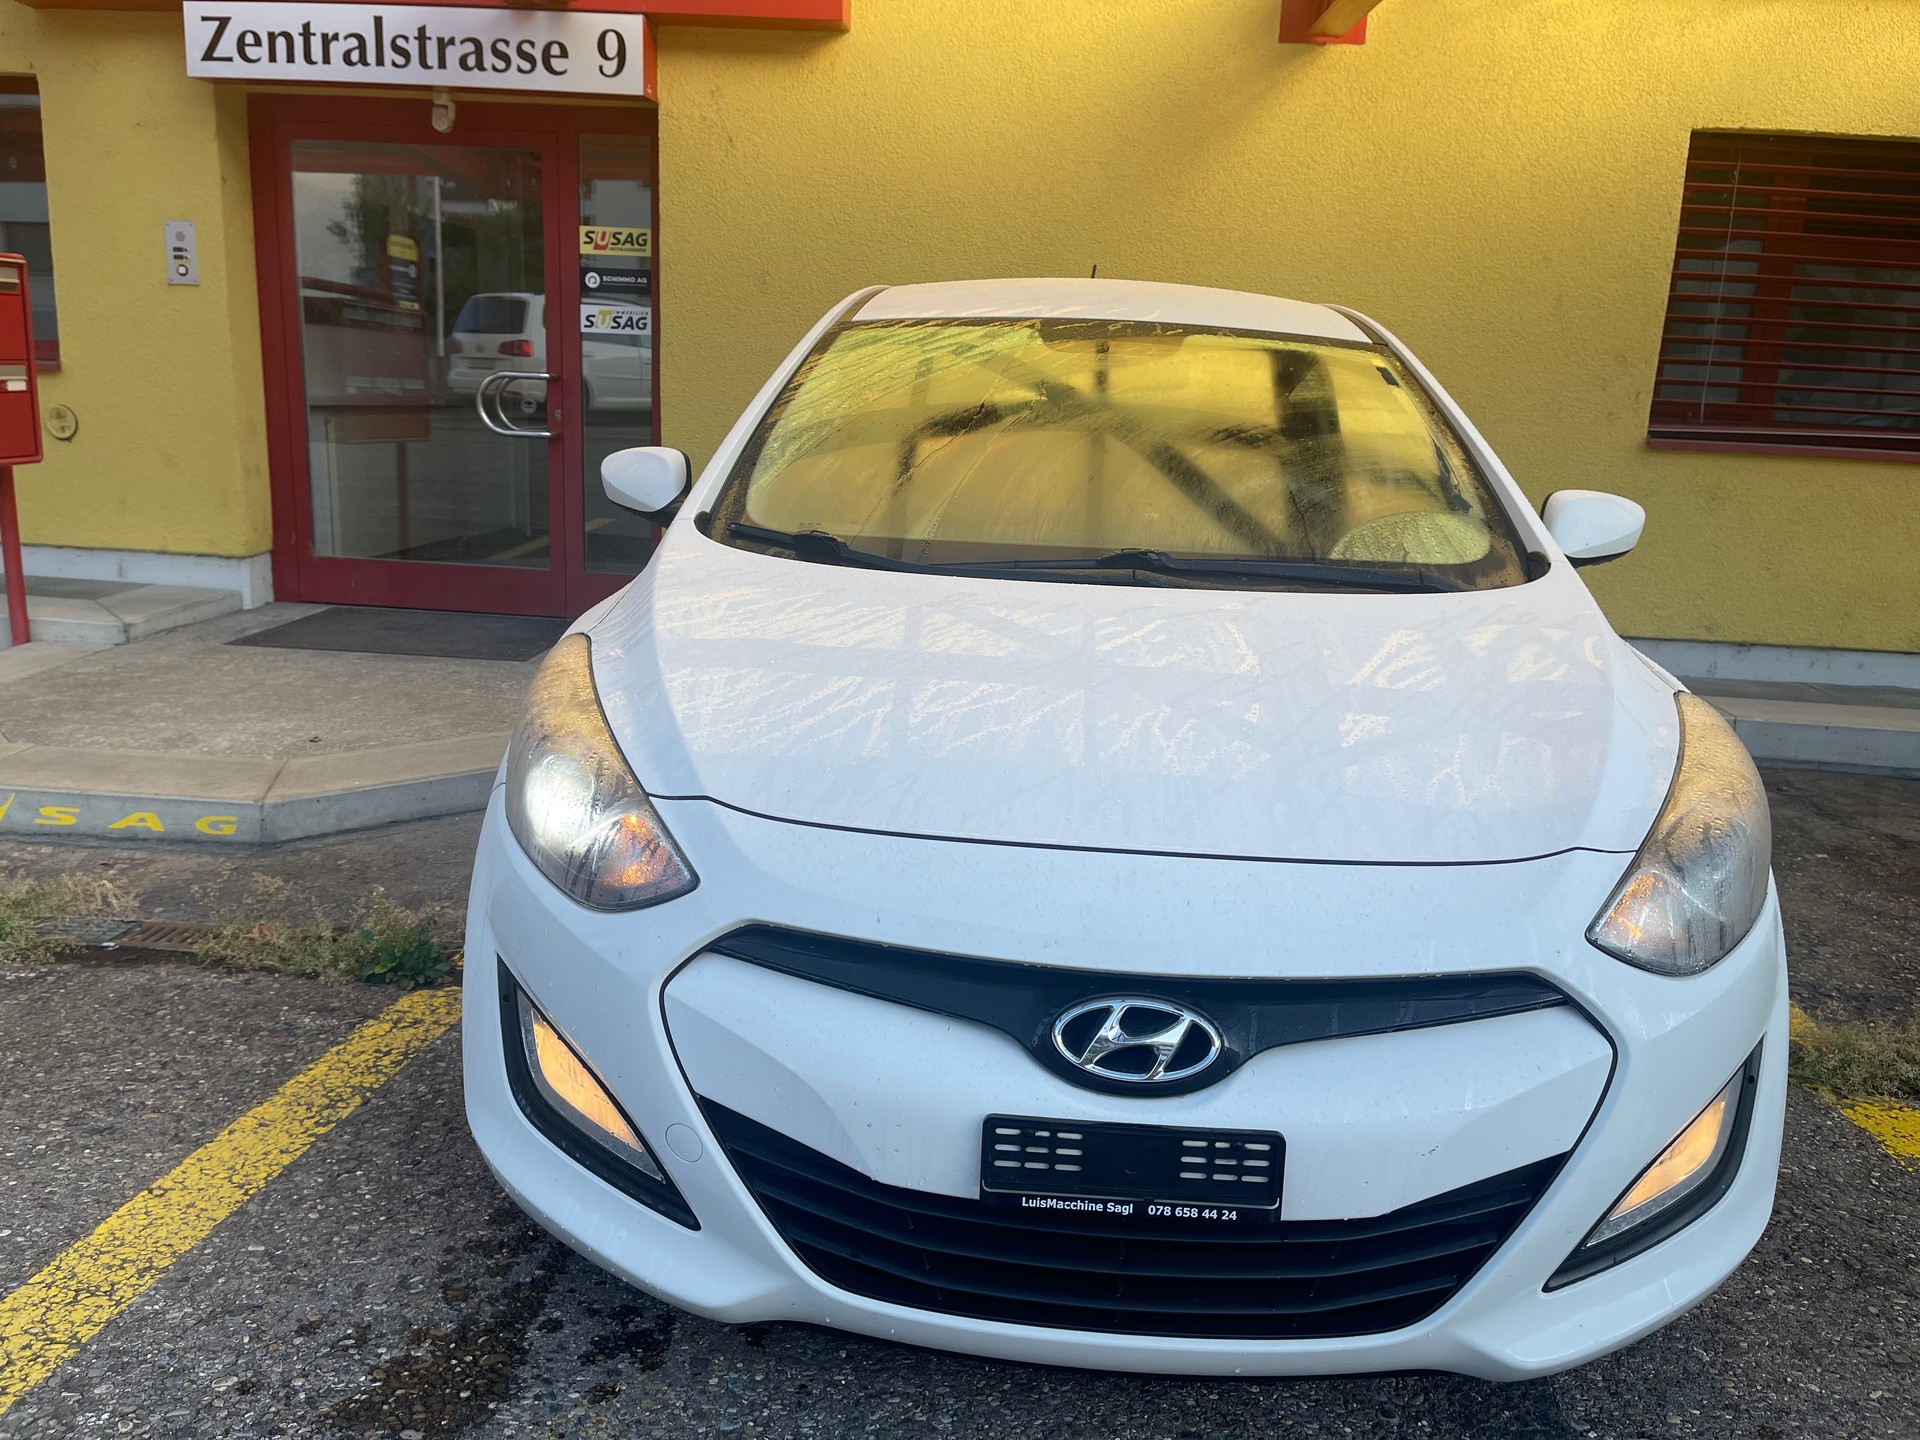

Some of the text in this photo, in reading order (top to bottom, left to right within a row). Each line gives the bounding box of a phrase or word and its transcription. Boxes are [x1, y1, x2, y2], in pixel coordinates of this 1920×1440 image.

[200, 15, 627, 78] Zentralstrasse 9
[583, 230, 648, 250] SUSAG
[1021, 1196, 1238, 1221] LuisMacchine Sagl 078 658 44 24
